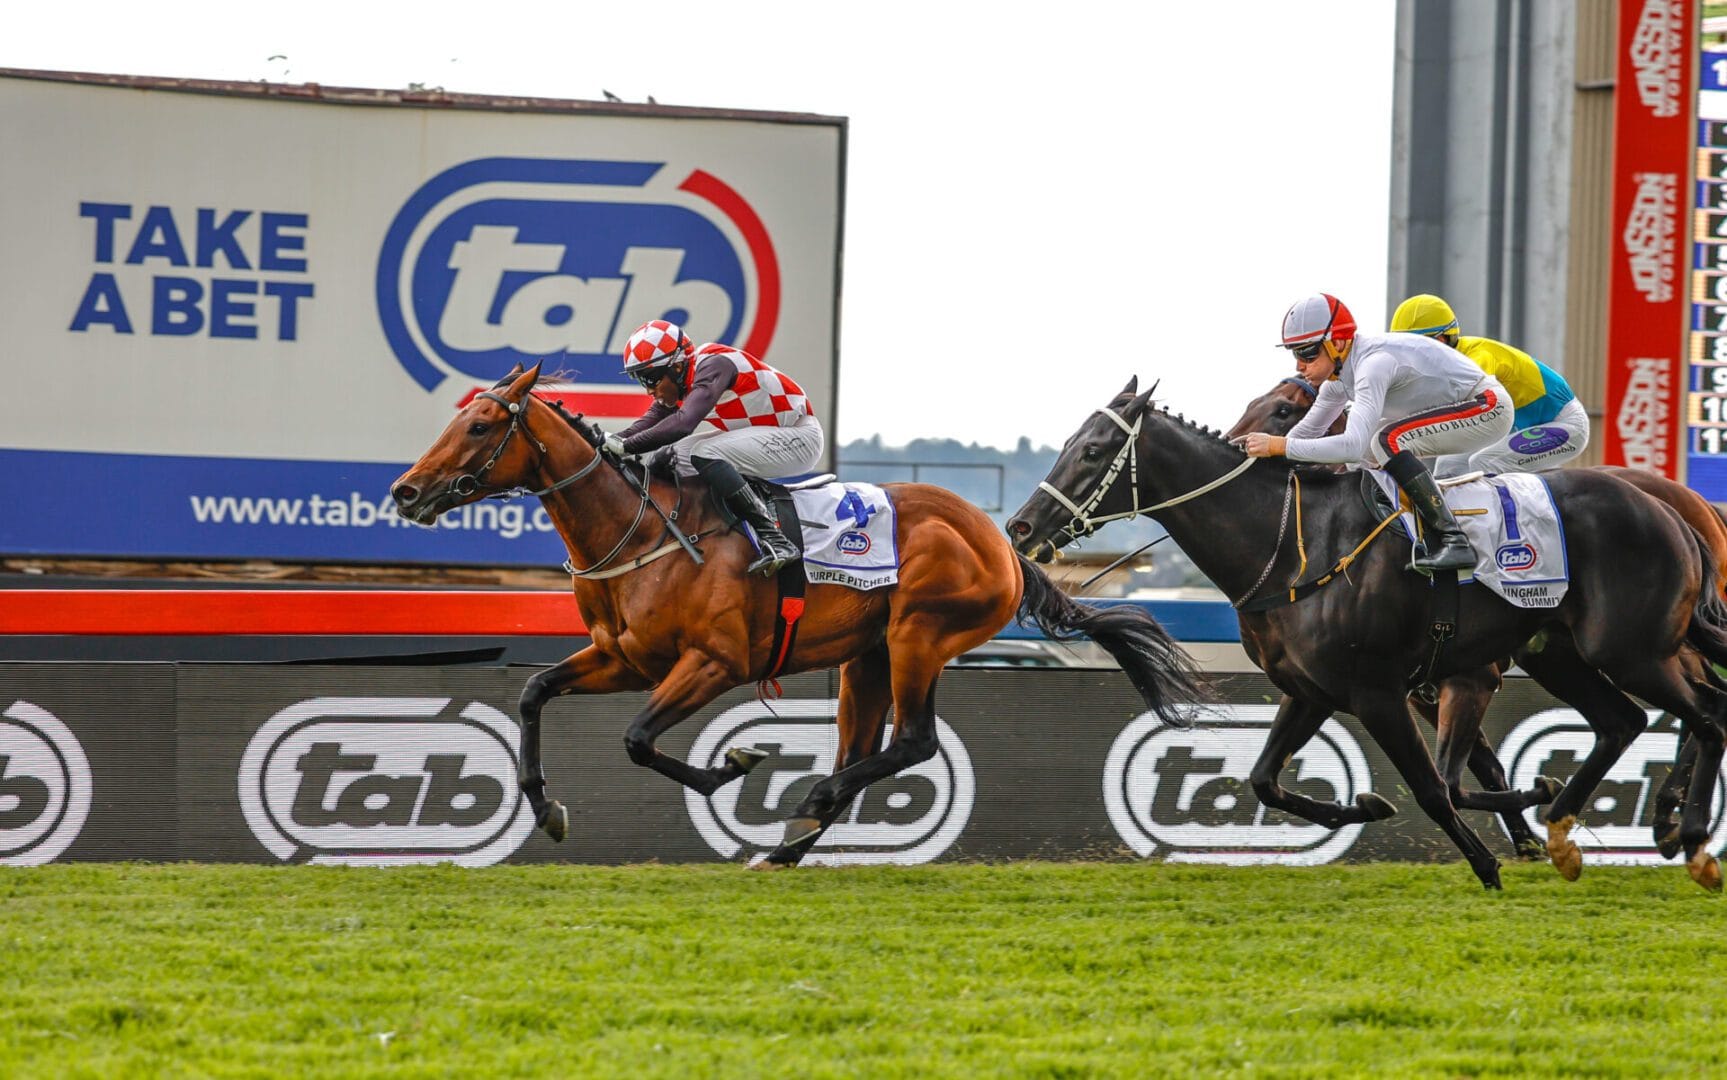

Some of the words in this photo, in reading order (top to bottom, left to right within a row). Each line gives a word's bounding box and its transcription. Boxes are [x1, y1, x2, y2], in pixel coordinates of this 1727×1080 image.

[1629, 0, 1668, 117] JONSSO
[1666, 0, 1683, 117] WORKWEA
[79, 202, 309, 273] TAKE
[1623, 173, 1664, 303] JONSSON
[1659, 173, 1678, 302] WORKWEAR
[69, 272, 135, 335] A
[151, 275, 314, 342] BET
[438, 225, 733, 355] tab
[1617, 358, 1656, 471] ONSSON
[1517, 453, 1547, 465] Calvin
[191, 492, 558, 538] www.tab4cing.c
[835, 491, 876, 528] 4
[841, 535, 866, 550] tab
[1496, 486, 1521, 540] 1
[847, 576, 890, 588] PITCHER
[1501, 551, 1531, 565] tab
[291, 742, 504, 827] tab
